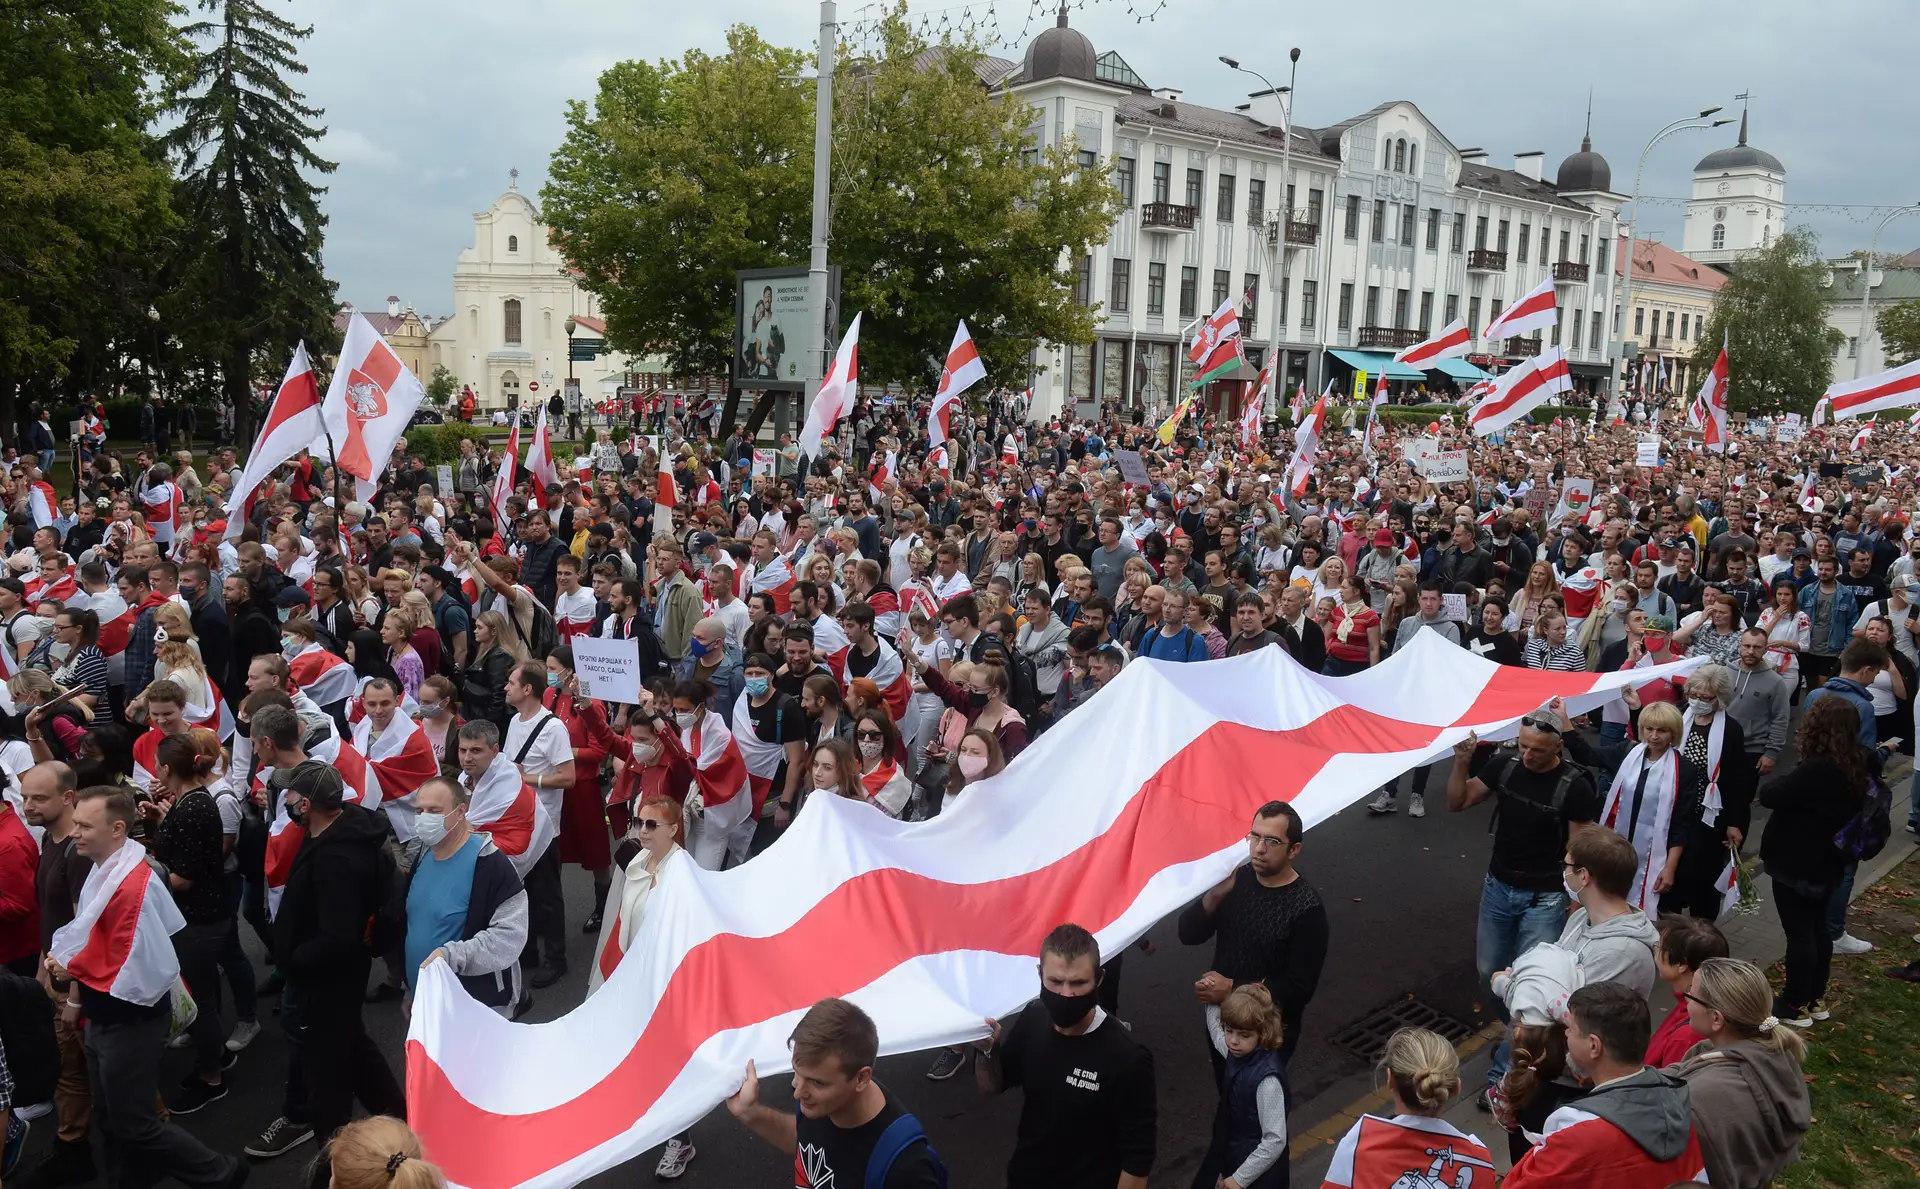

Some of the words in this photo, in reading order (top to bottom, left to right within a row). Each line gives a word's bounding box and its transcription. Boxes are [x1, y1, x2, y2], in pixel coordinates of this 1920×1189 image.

[1442, 452, 1463, 460] ПРОЧЬ
[598, 656, 622, 664] АРЭШАК
[584, 665, 607, 673] ТАКОГО,
[607, 667, 627, 675] САША,
[1073, 1067, 1082, 1077] НЕ
[1081, 1070, 1098, 1081] СТОЙ
[1065, 1075, 1078, 1087] НАД
[1077, 1079, 1100, 1091] ДУШОЙ
